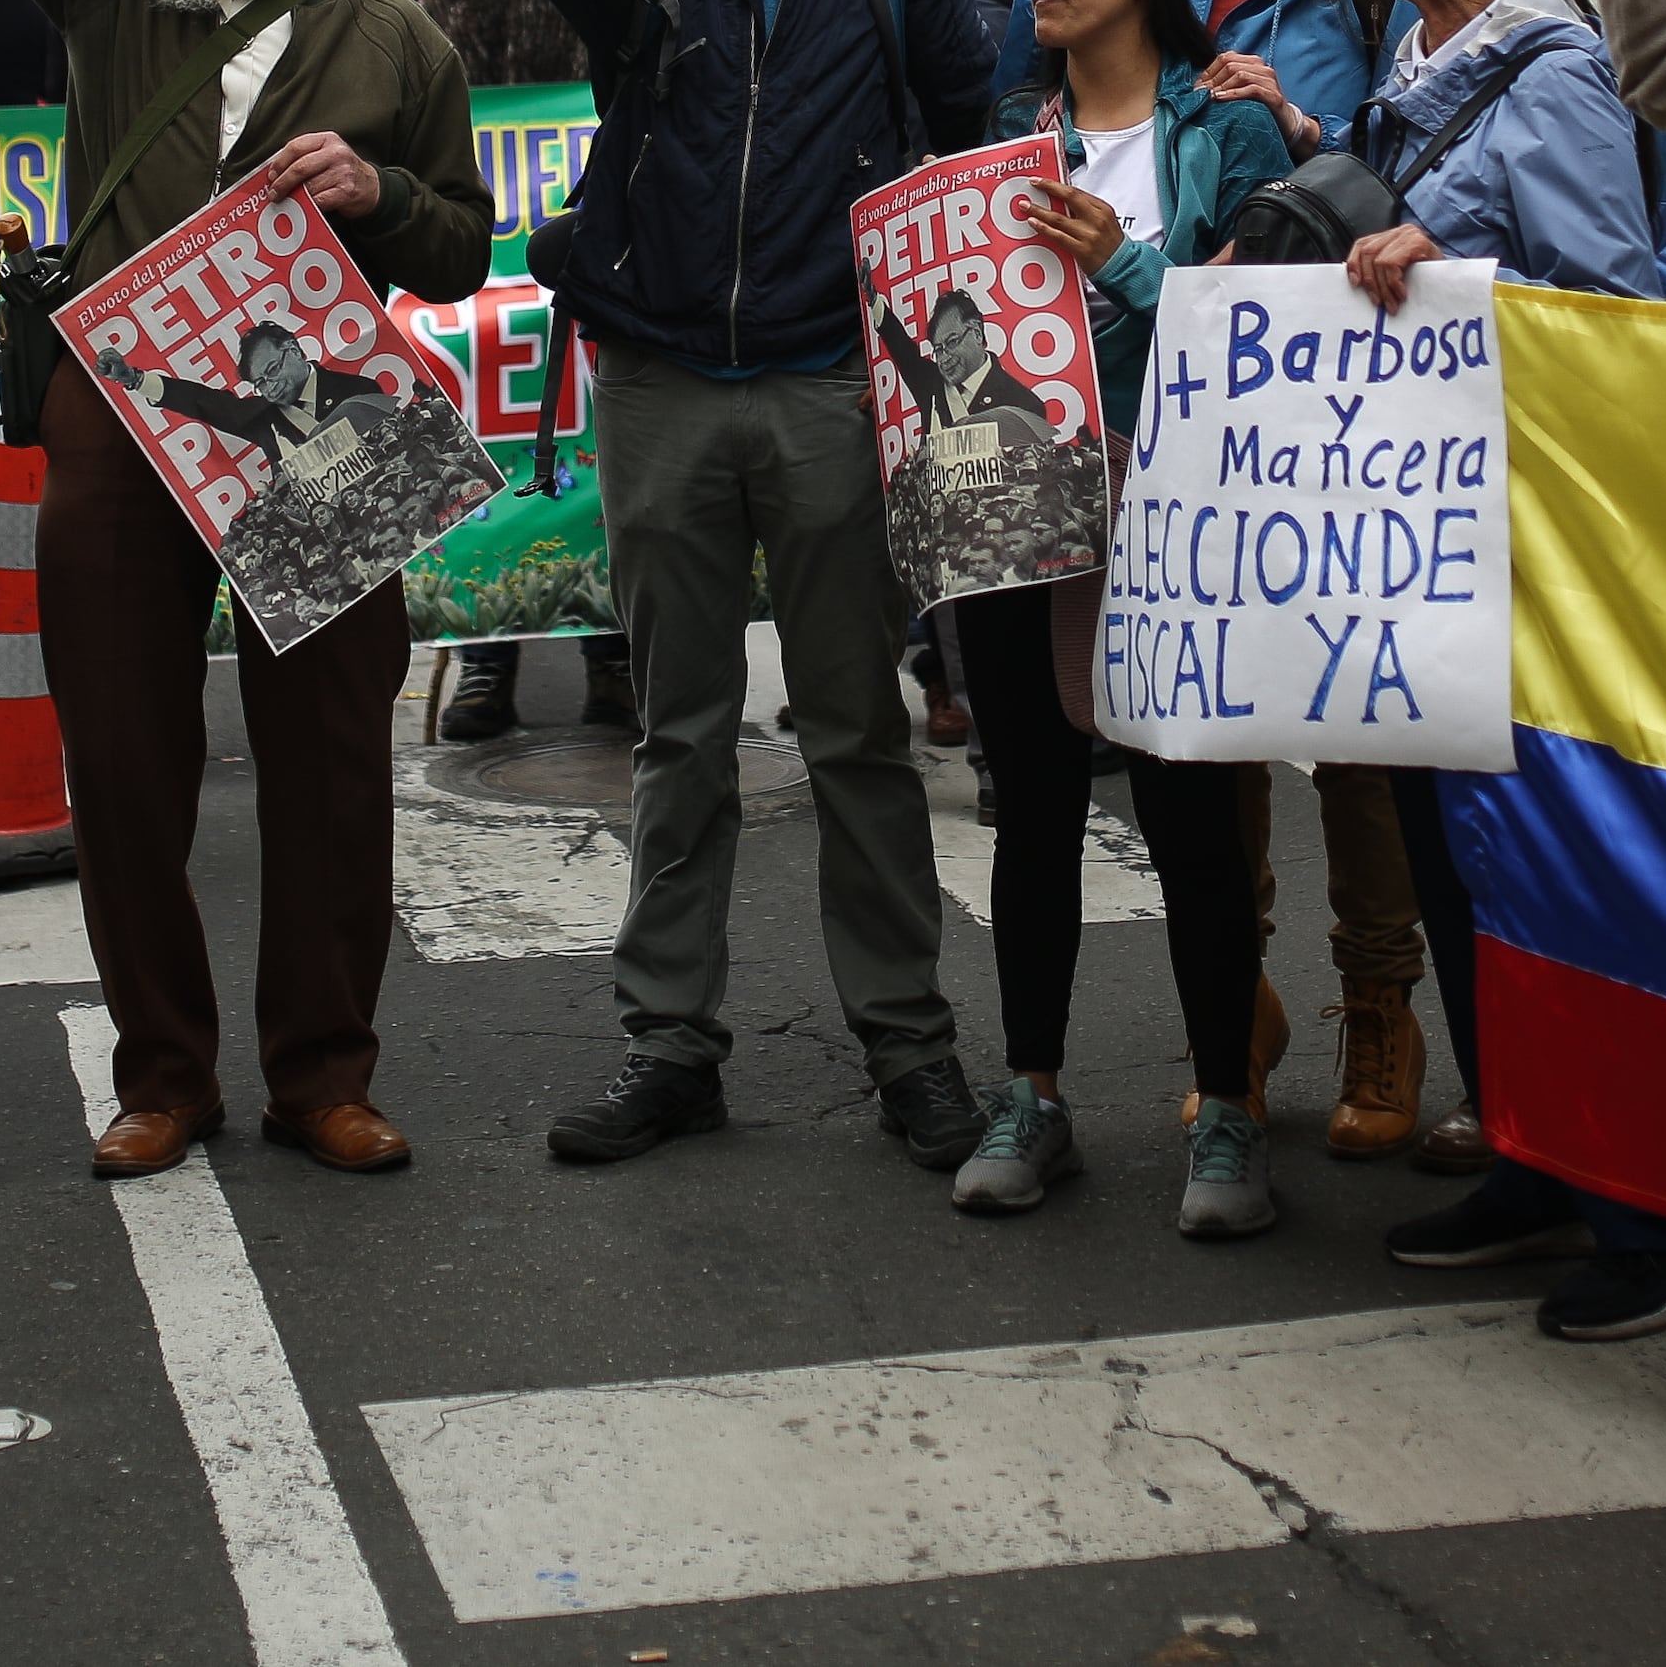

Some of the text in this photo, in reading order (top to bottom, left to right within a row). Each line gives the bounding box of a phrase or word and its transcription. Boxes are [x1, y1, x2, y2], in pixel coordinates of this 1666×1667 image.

[858, 211, 869, 229] El
[868, 202, 890, 223] voto
[892, 189, 908, 212] del
[908, 175, 949, 207] pueblo
[974, 149, 1041, 180] respeta!
[858, 175, 1051, 280] PETRO
[1116, 216, 1136, 230] IT
[77, 306, 96, 329] El
[96, 286, 130, 315] voto
[131, 266, 155, 291] del
[156, 231, 205, 280] pueblo
[228, 184, 273, 222] respet
[85, 196, 308, 357] PETRO
[1227, 301, 1490, 400] Barbosa
[1220, 425, 1487, 496] Mancera
[1104, 613, 1424, 724] FISCAL YA
